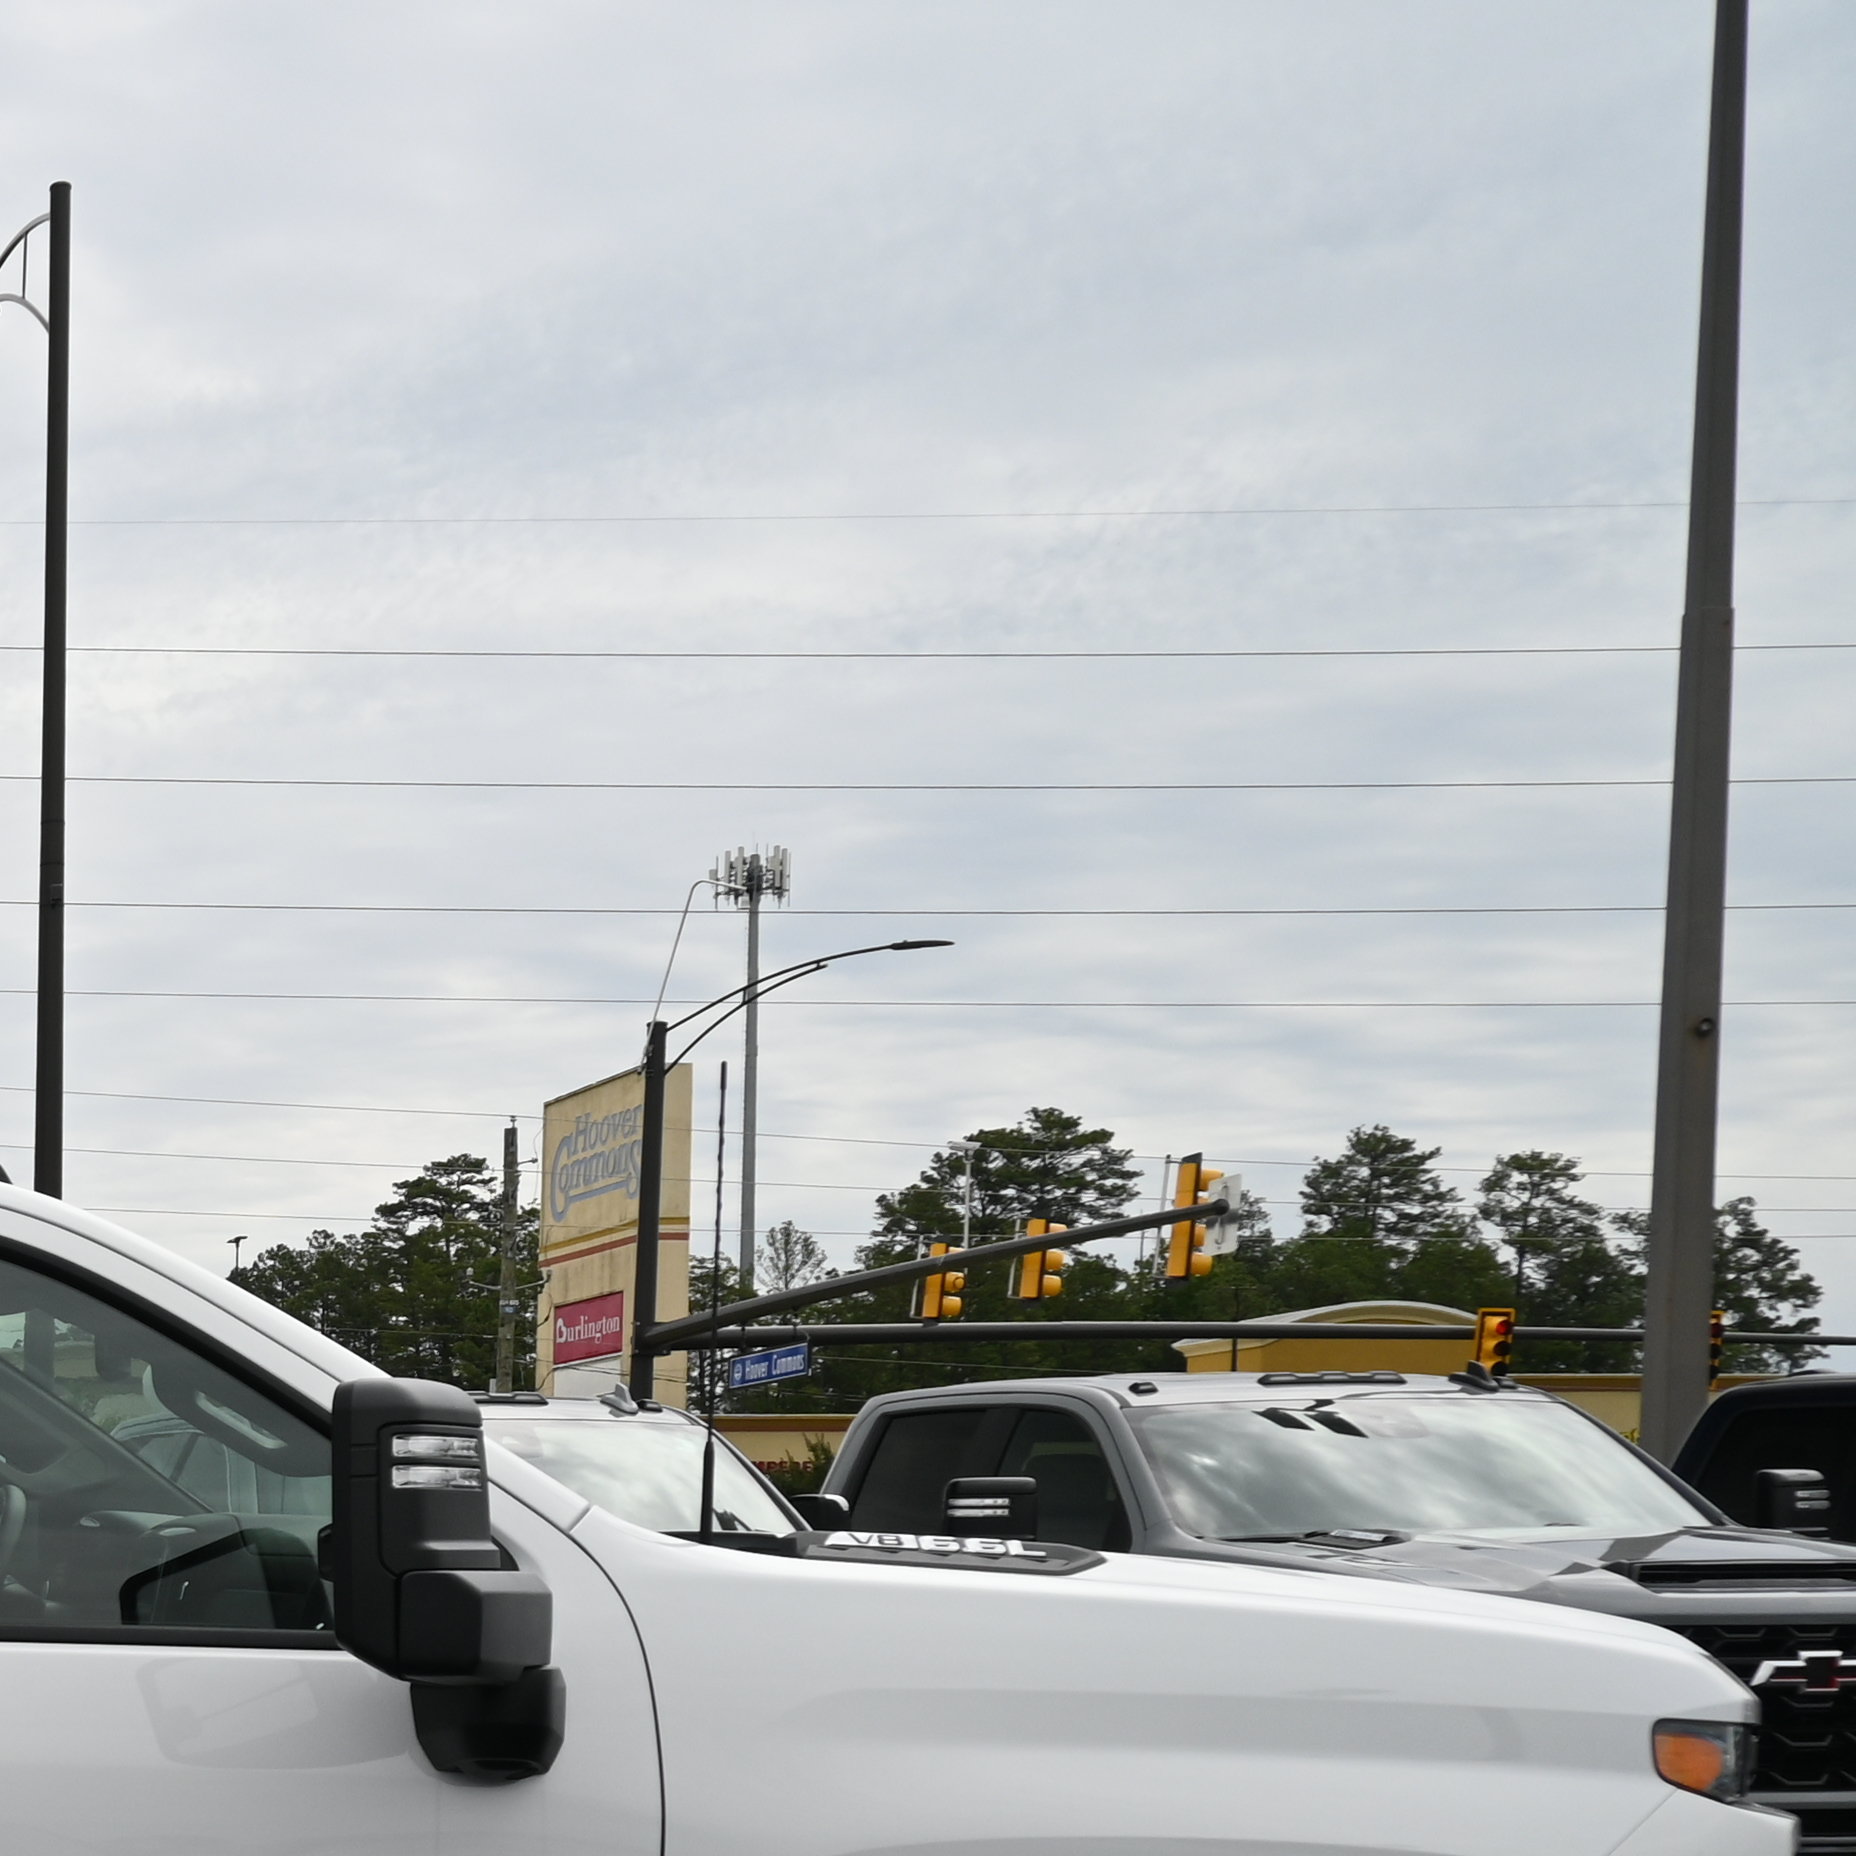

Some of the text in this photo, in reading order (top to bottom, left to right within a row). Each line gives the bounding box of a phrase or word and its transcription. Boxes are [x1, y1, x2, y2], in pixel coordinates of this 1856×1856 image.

[571, 1104, 643, 1155] Hoover
[551, 1132, 642, 1222] Commons
[556, 1315, 620, 1344] Burlington
[745, 1354, 805, 1380] Hoover Commons
[848, 1533, 904, 1546] V8
